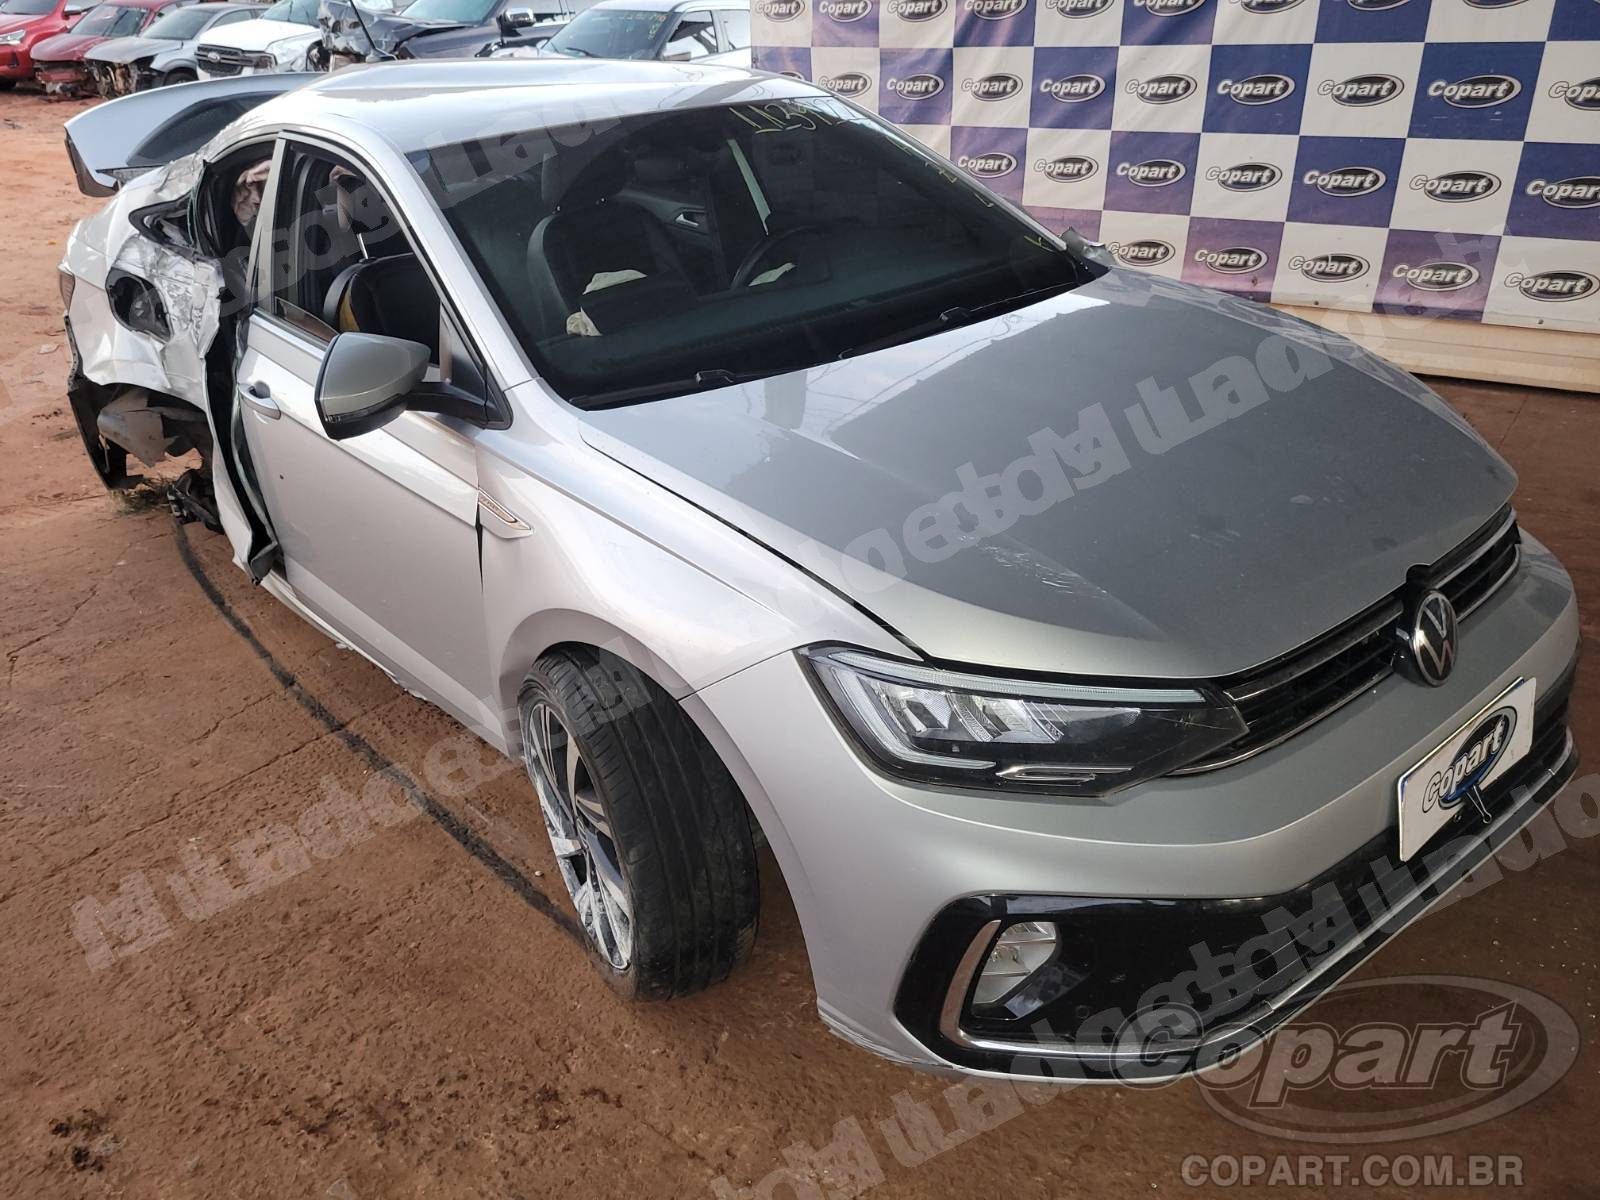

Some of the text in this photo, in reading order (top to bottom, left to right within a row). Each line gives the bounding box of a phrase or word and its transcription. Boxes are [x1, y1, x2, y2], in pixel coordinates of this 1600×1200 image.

[755, 0, 798, 15] Copart
[819, 0, 866, 16] Copart
[887, 0, 938, 15] Copart
[963, 0, 1018, 13] Copart
[818, 76, 864, 92] Copart
[886, 77, 936, 94] Copart
[961, 78, 1014, 95] Copart
[1040, 79, 1098, 97] Copart
[1125, 79, 1187, 97] Copart
[1216, 79, 1284, 98] Copart
[1317, 79, 1392, 98] Copart
[1428, 80, 1508, 100] Copart
[957, 156, 1009, 172] Copart
[1034, 159, 1090, 177] Copart
[1116, 162, 1178, 181] Copart
[1205, 165, 1271, 184] Copart
[1303, 169, 1375, 189] Copart
[1409, 174, 1488, 196] Copart
[1525, 178, 1600, 201] Copar
[1106, 241, 1166, 260] Copart
[1193, 250, 1258, 269] Copart
[1288, 255, 1359, 276] Copart
[1392, 263, 1470, 285] Copart
[1504, 271, 1589, 296] Copart
[1421, 713, 1507, 814] Copart
